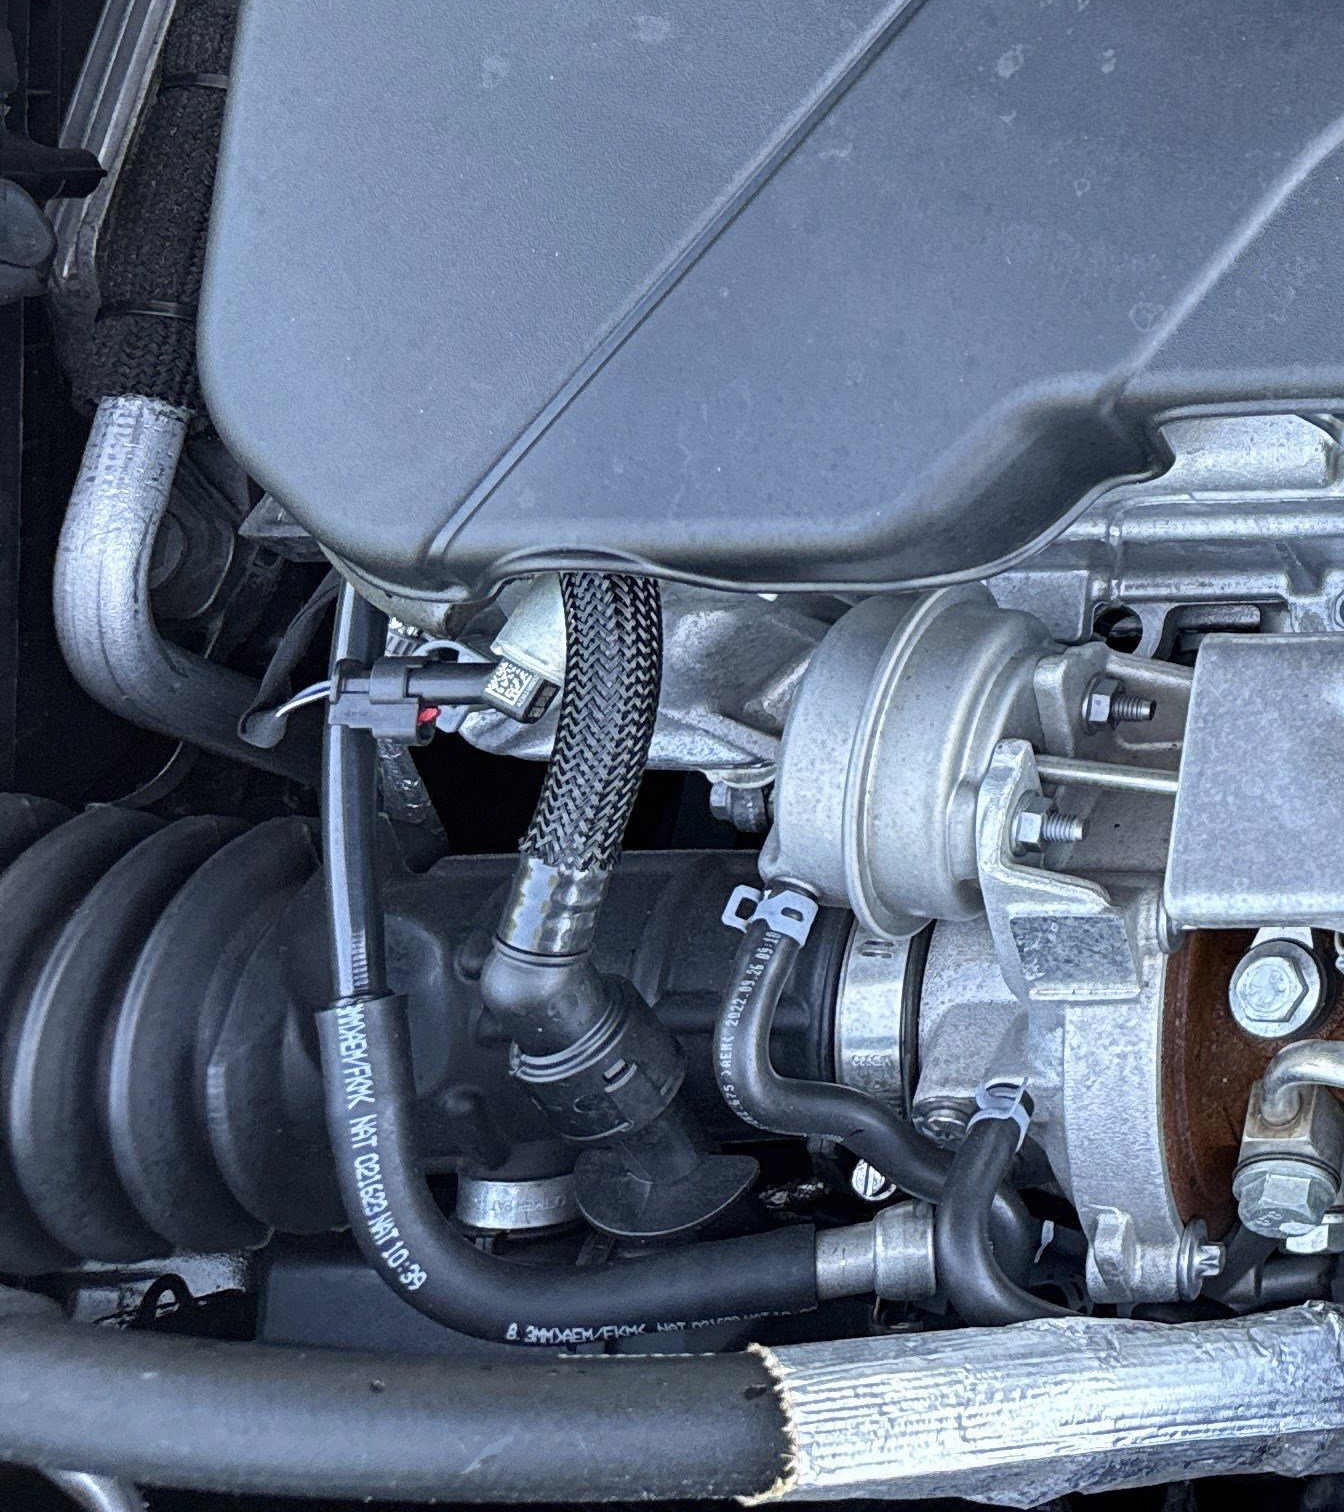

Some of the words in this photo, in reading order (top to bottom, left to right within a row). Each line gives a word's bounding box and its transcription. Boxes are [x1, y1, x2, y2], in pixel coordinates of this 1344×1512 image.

[349, 1113, 378, 1148] NAT
[354, 1153, 389, 1217] 021623
[367, 1212, 400, 1246] NAT
[382, 1240, 428, 1291] 10:39
